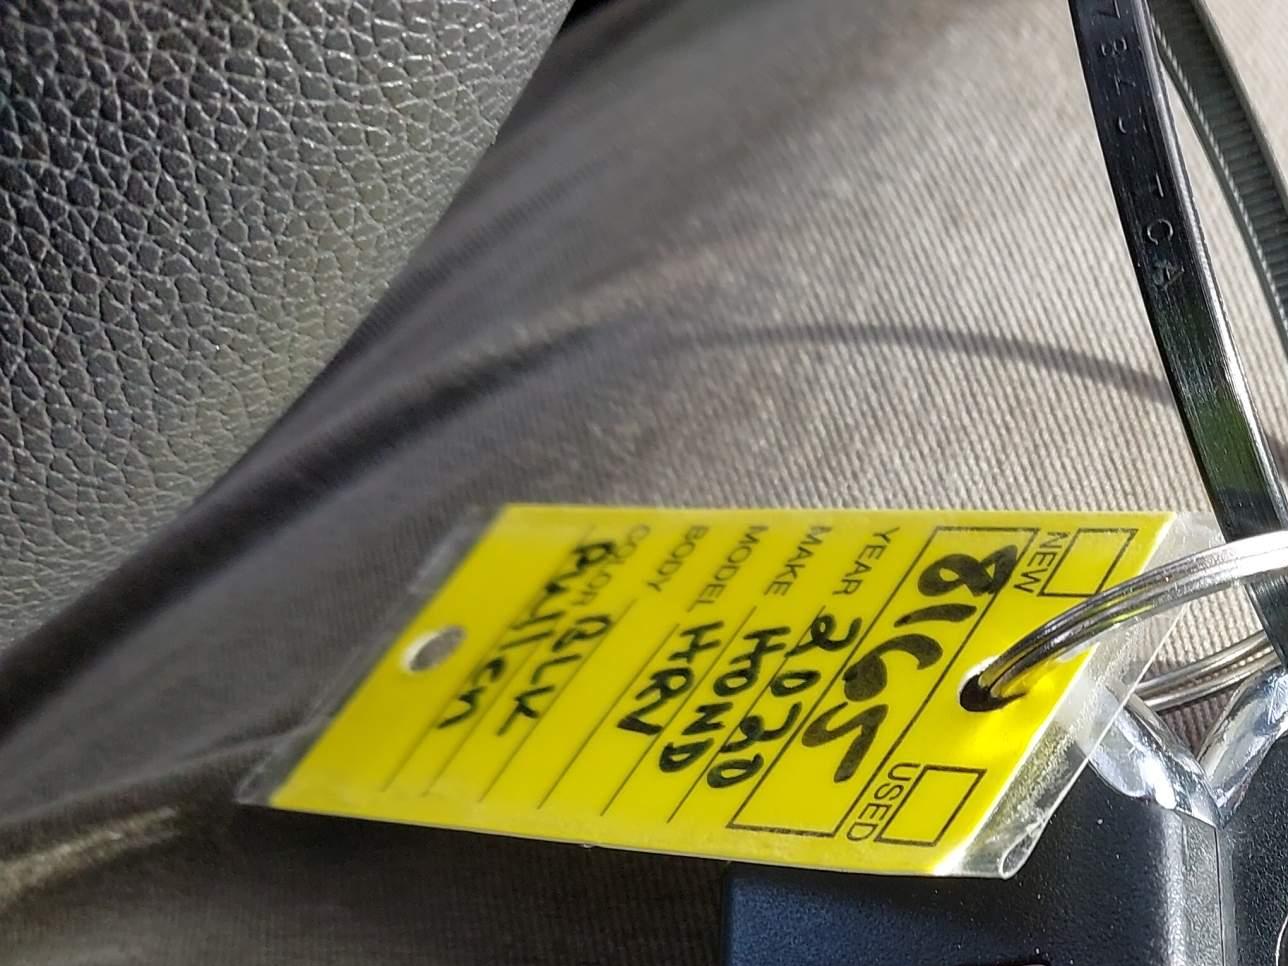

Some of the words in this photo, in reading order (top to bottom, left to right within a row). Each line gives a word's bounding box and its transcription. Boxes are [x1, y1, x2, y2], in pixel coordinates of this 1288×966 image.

[646, 525, 710, 592] BODY
[697, 525, 769, 606] MODEL
[764, 525, 833, 597] MAKE
[831, 526, 901, 596] YEAR
[1013, 530, 1070, 595] NEW
[617, 620, 726, 736] HRV
[658, 626, 791, 773] HOND
[706, 613, 863, 789] 2020
[801, 544, 1019, 784] 8165
[846, 761, 921, 842] USED
